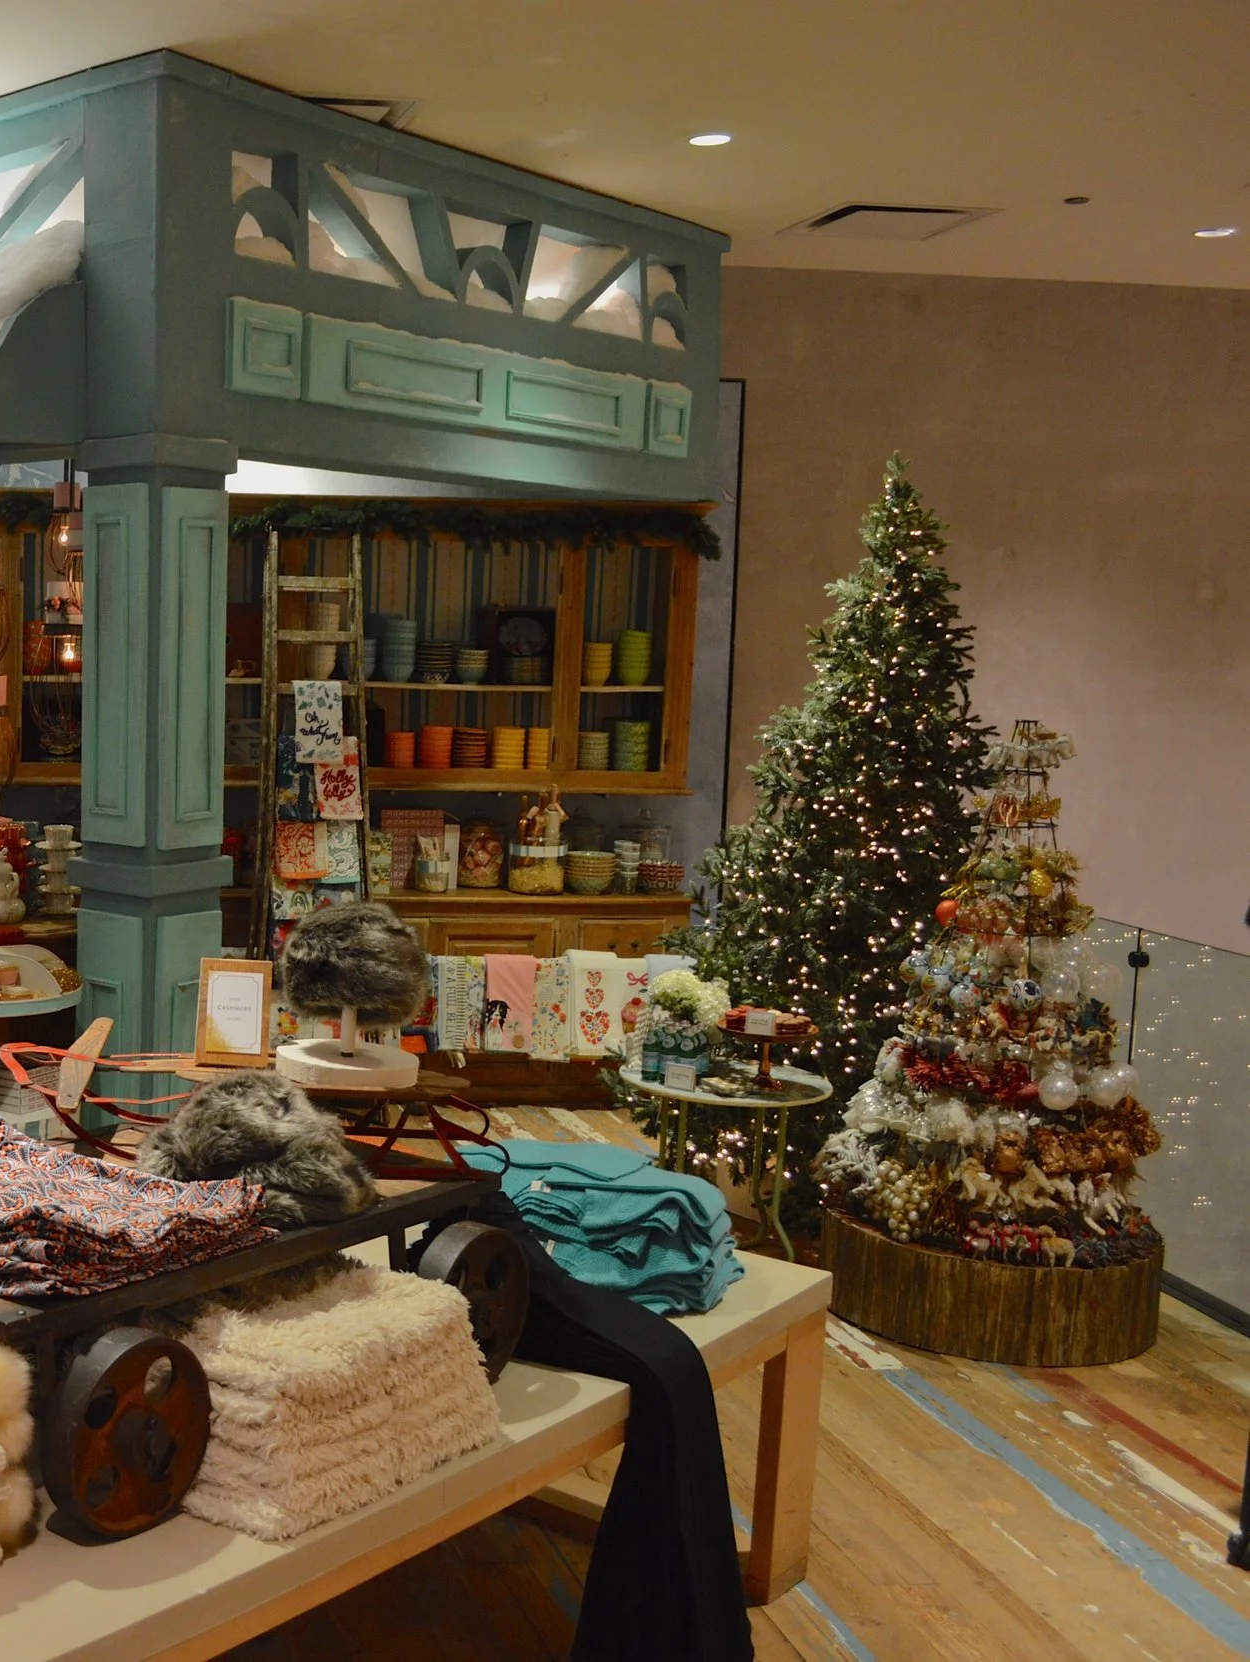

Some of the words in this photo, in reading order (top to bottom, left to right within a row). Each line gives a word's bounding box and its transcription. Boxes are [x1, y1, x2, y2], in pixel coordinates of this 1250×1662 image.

[320, 769, 357, 789] Holly
[445, 986, 456, 1008] FULL
[445, 1012, 456, 1040] BELLY
